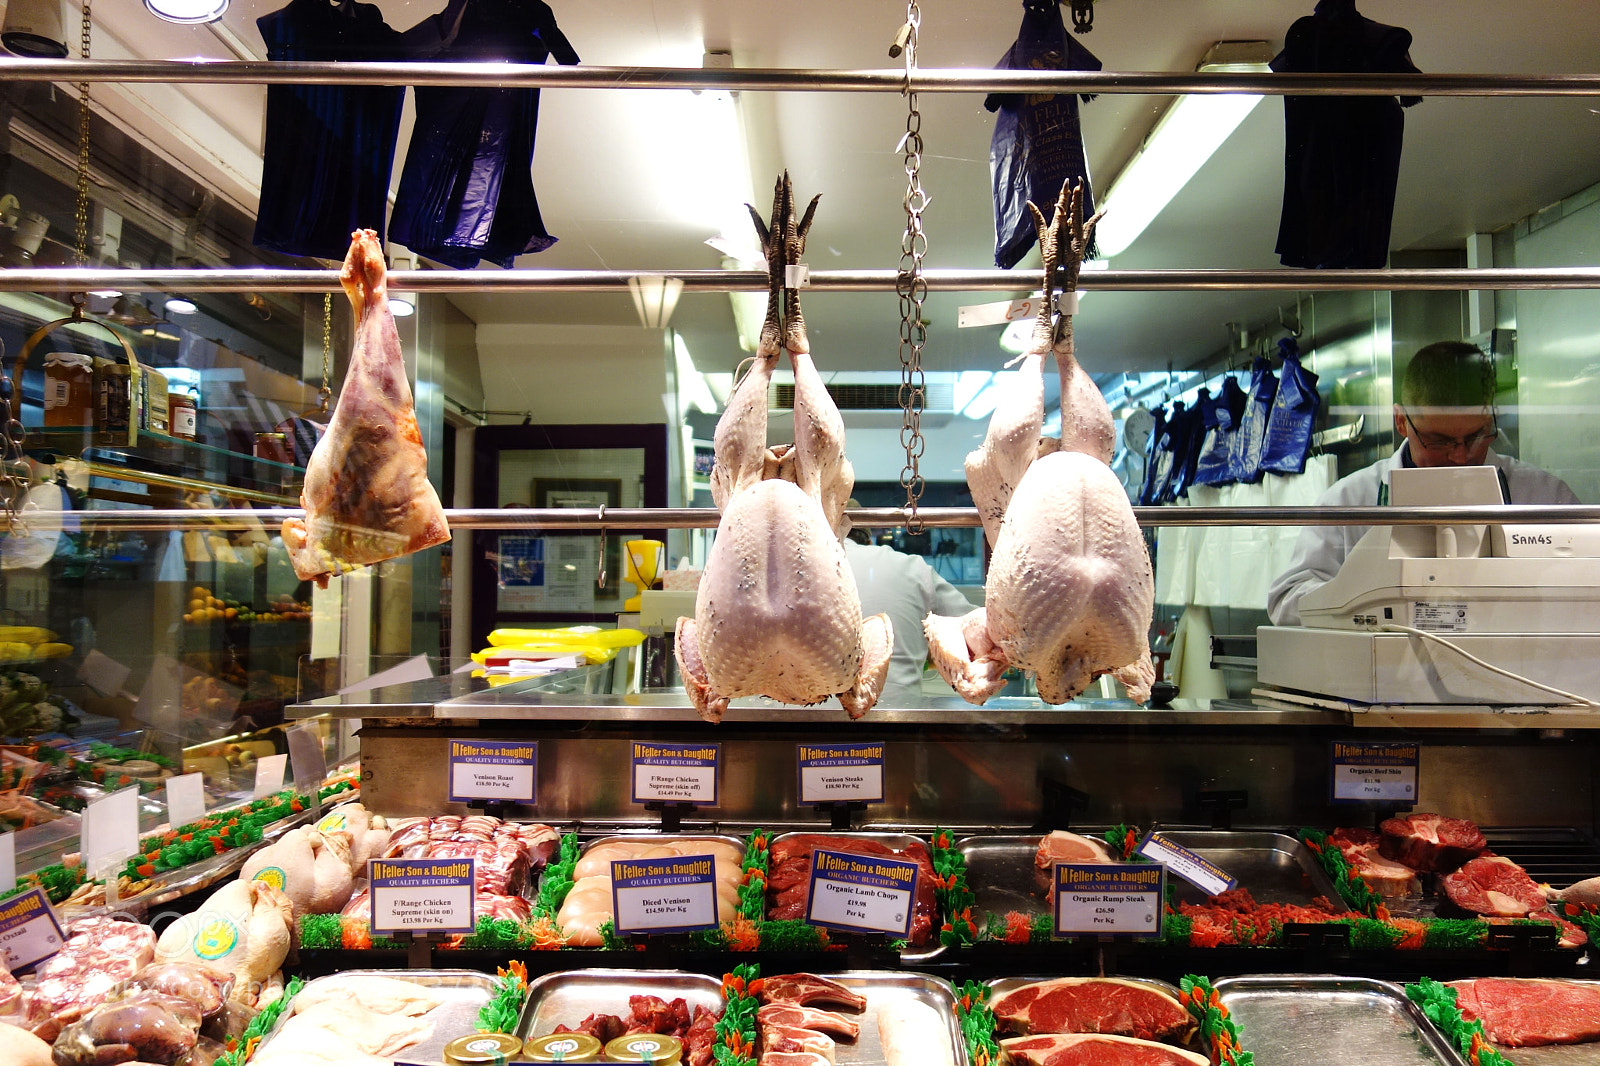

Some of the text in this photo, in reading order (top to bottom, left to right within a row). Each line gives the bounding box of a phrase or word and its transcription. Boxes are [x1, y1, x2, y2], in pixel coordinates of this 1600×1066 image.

[452, 742, 459, 757] M
[460, 744, 479, 756] Feller
[480, 747, 493, 756] Son
[501, 746, 534, 759] Daughter
[634, 744, 641, 758] M
[642, 746, 662, 757] Feller
[662, 748, 676, 757] Son
[683, 748, 716, 760] Daughter
[800, 747, 807, 761] M
[808, 748, 828, 760] Feller
[829, 749, 842, 758] Son
[850, 746, 882, 759] Daughter
[1334, 743, 1341, 758] M
[1342, 744, 1362, 757] Feller
[1363, 747, 1377, 756] Son
[1385, 747, 1416, 759] Daughter
[817, 851, 914, 883] M Feller Son & Daughter
[1159, 837, 1179, 850] Feller
[1179, 848, 1194, 858] Son
[1200, 859, 1233, 882] Daughter
[373, 862, 470, 880] M Feller Son & Daughter
[614, 860, 711, 881] M Feller Son & Daughter
[1060, 866, 1160, 885] M Feller Son & Daughter
[630, 876, 701, 886] QUALITY BUTCHERS
[827, 871, 899, 887] ORGANIC BUTCHERS
[826, 883, 899, 900] Organic Lamb Chops
[1072, 895, 1101, 903] Organic
[1102, 895, 1125, 903] Rump
[642, 898, 662, 906] Diced
[847, 899, 867, 907] £19.98
[391, 909, 422, 917] Supreme
[846, 909, 866, 919] Per kg
[3, 927, 27, 941] Oxtail
